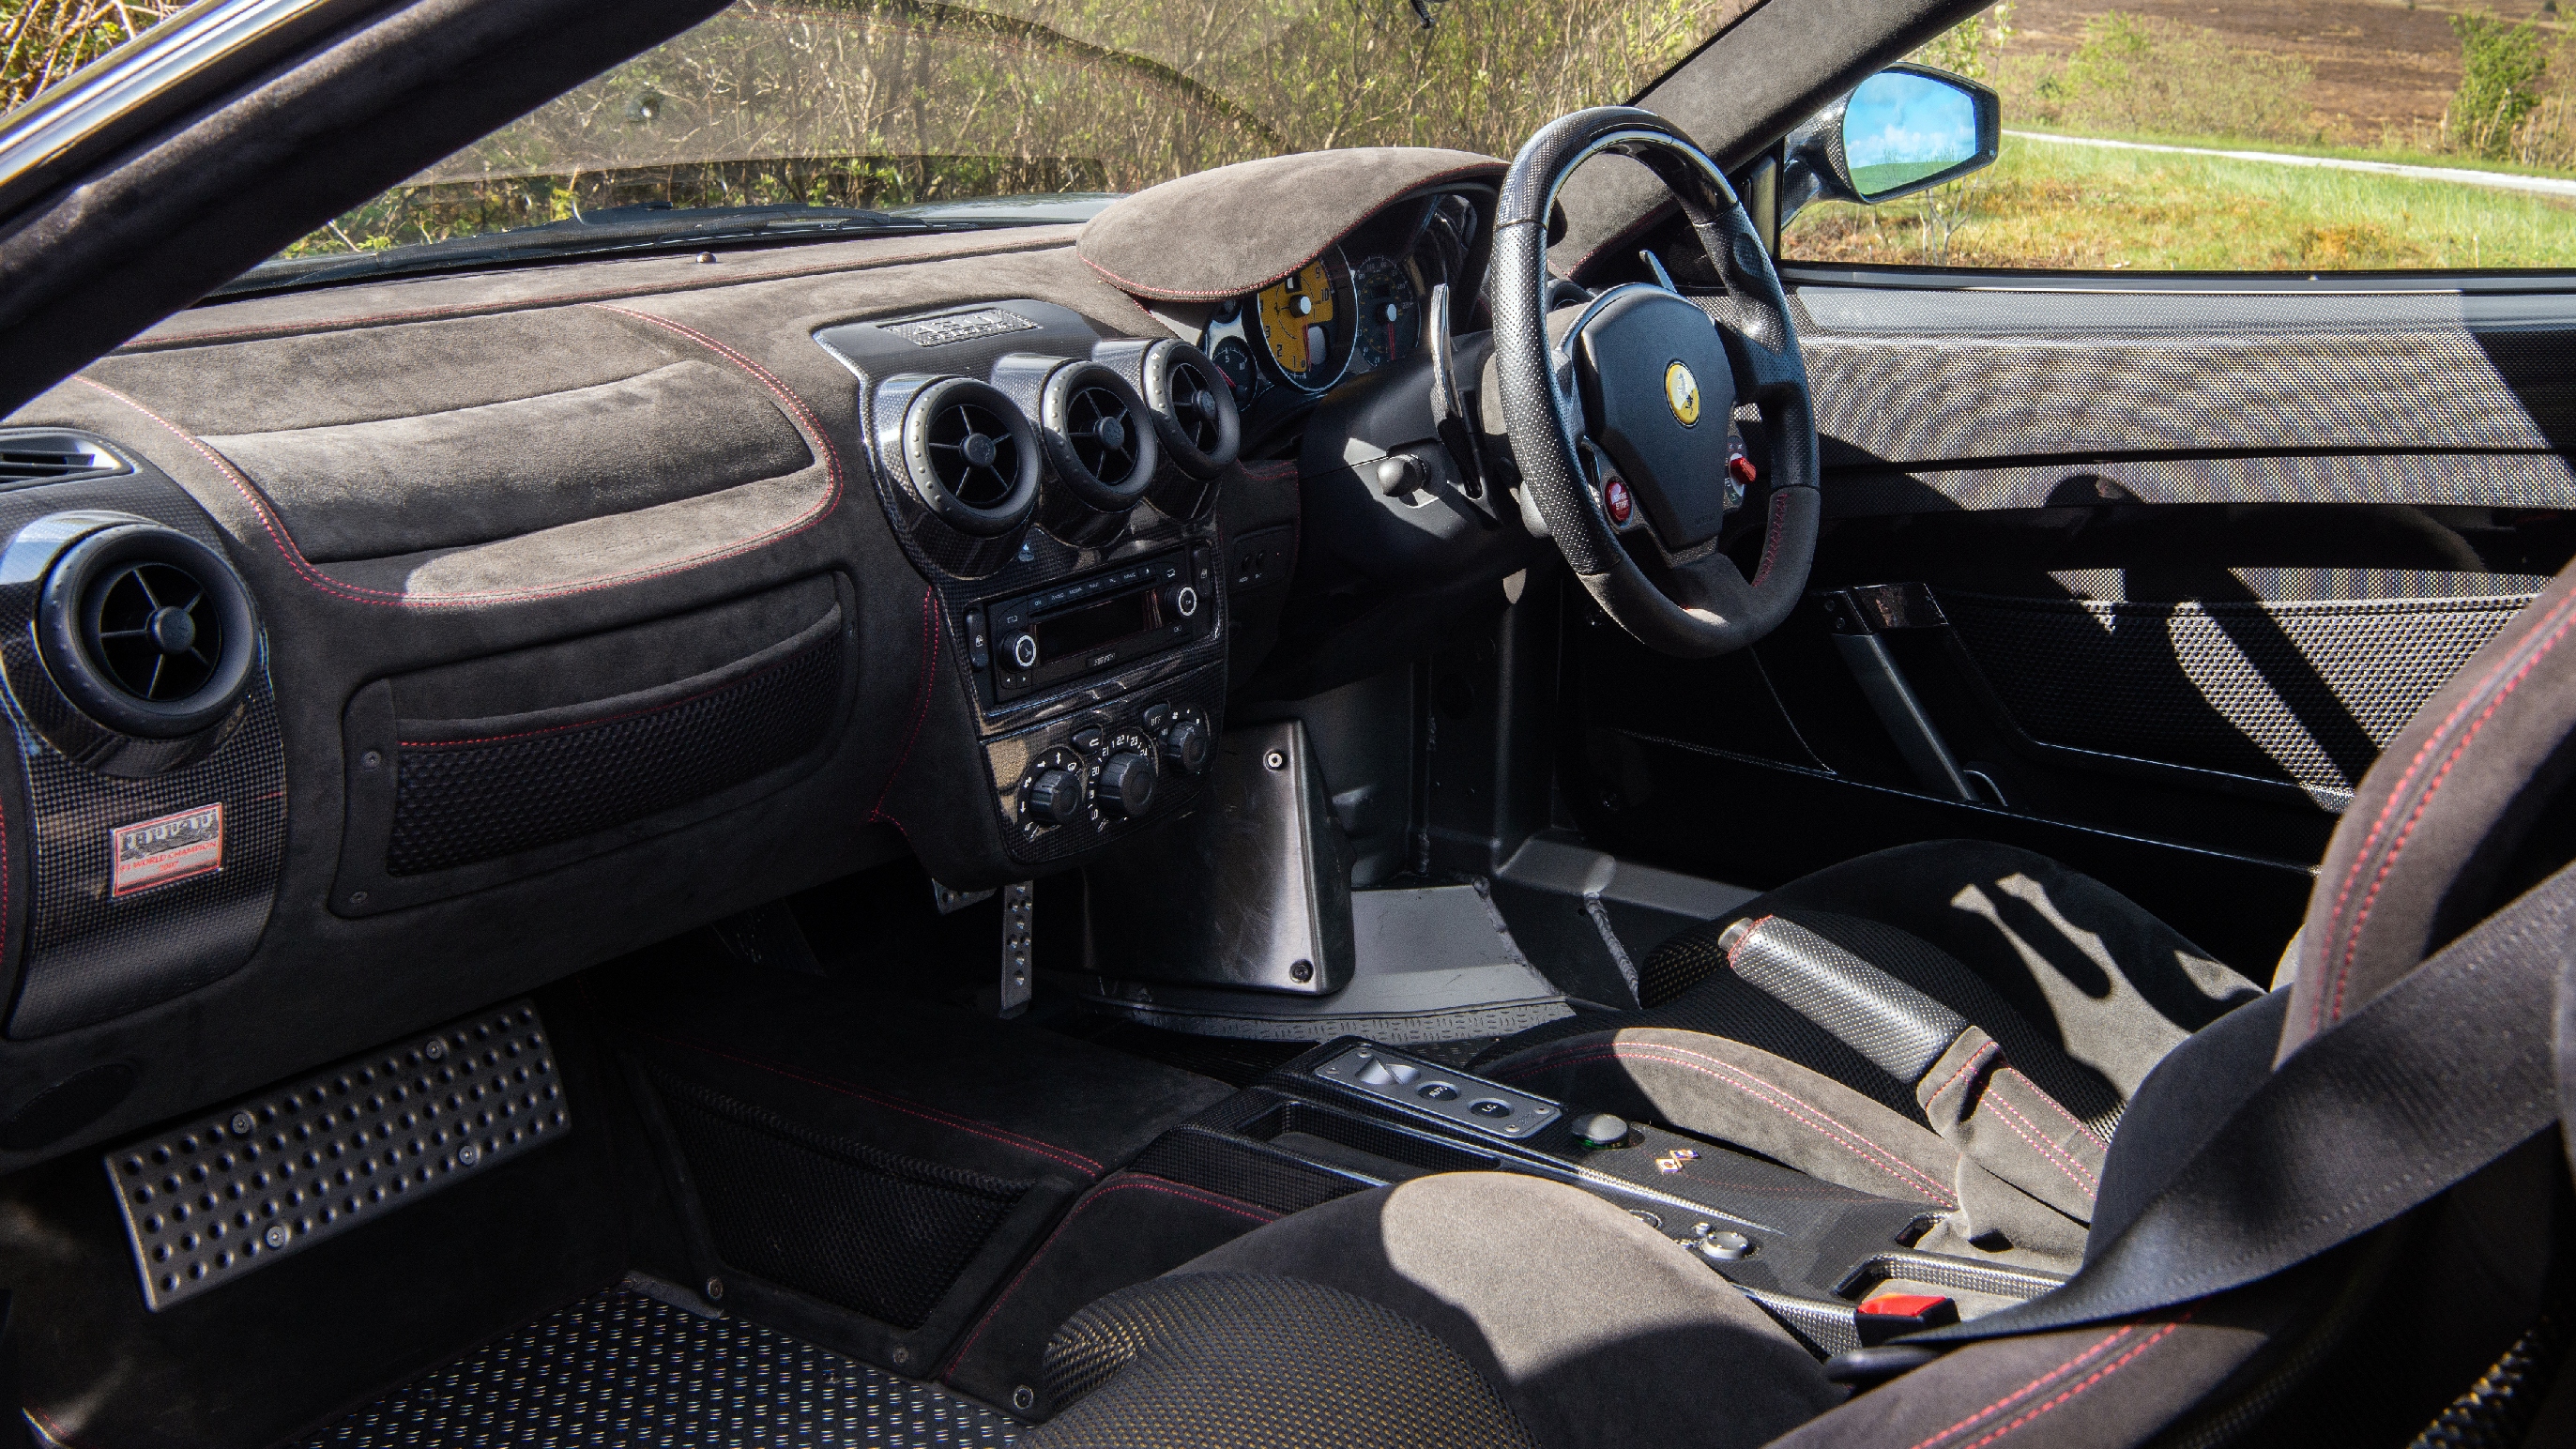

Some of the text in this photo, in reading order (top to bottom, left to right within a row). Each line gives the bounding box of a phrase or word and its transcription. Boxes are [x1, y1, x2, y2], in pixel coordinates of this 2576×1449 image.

[1321, 287, 1330, 302] 10
[1264, 325, 1271, 339] 3
[1276, 343, 1283, 358] 2
[1116, 734, 1125, 746] 22
[1130, 735, 1138, 747] 23
[1102, 746, 1109, 757] 21
[1091, 766, 1100, 777] 20
[133, 855, 167, 869] WORLD
[168, 840, 218, 859] CHAMPION
[160, 860, 179, 872] 2007
